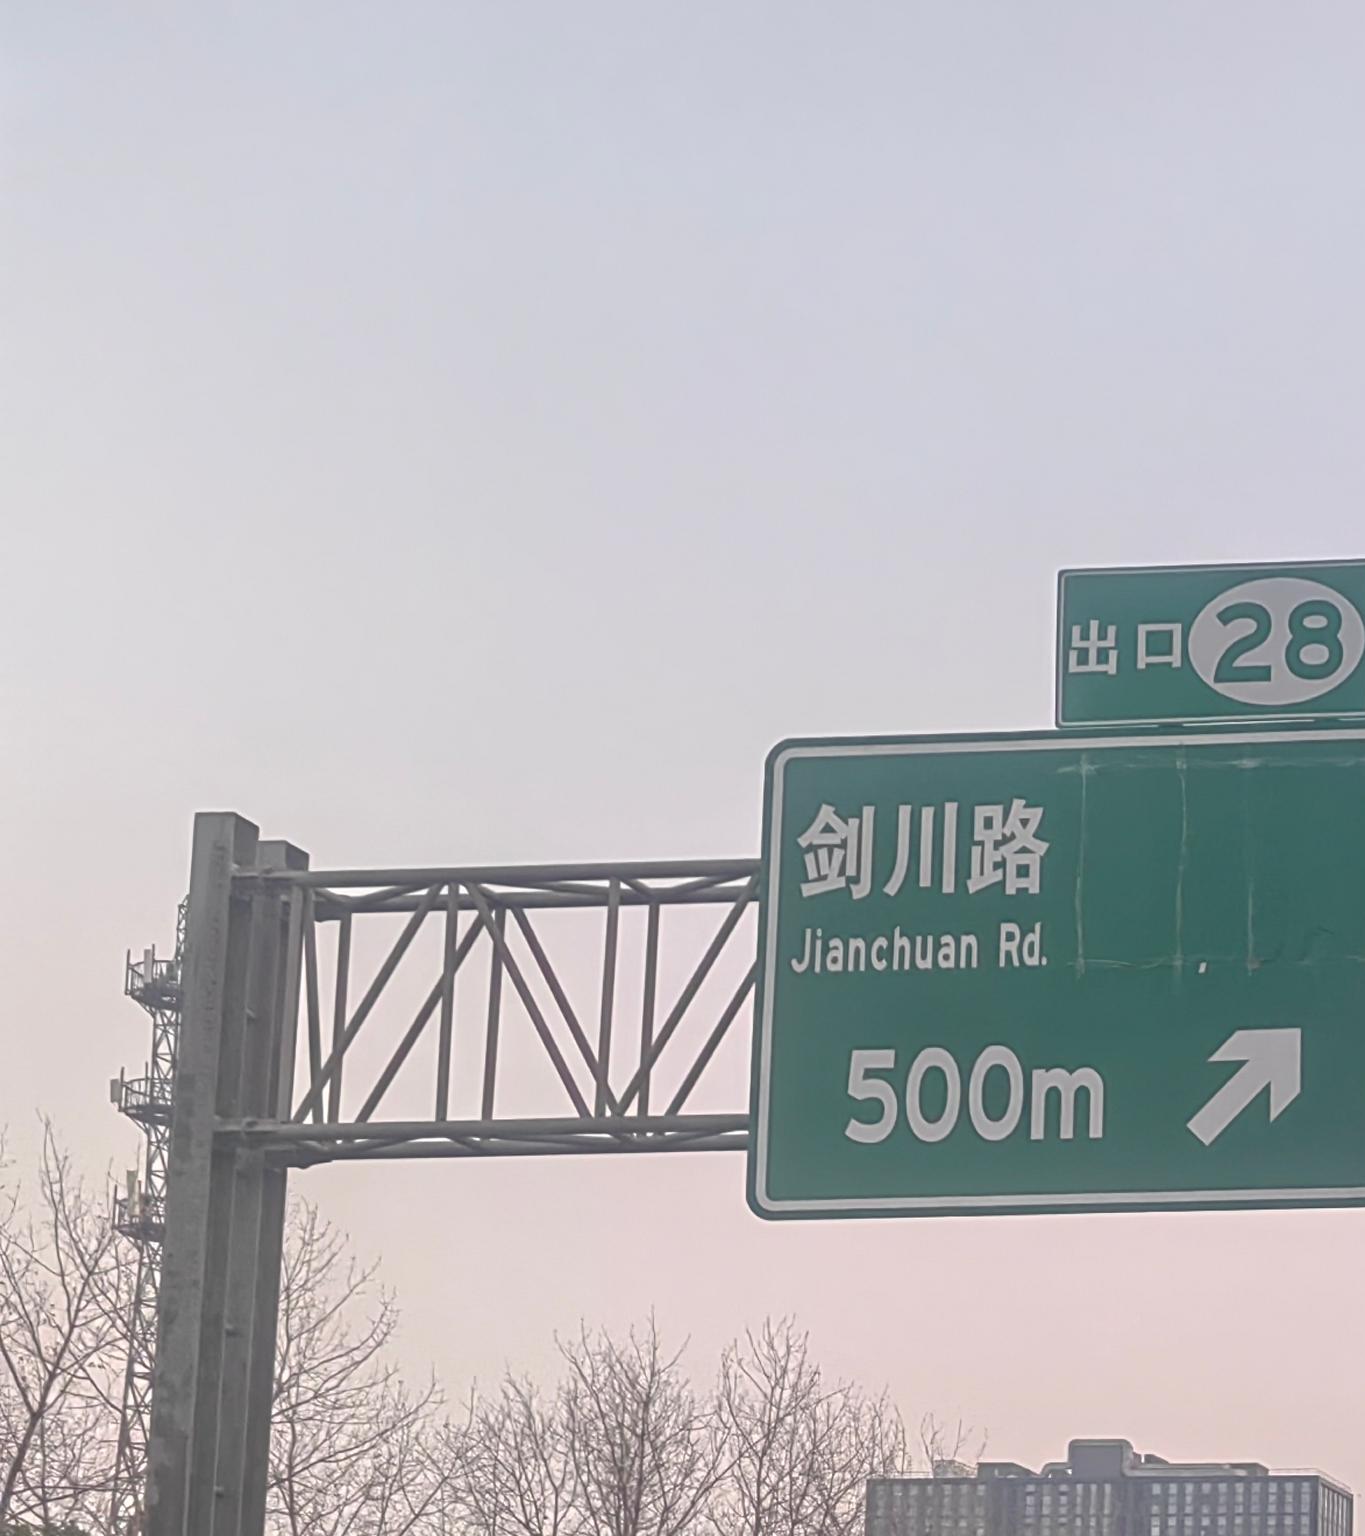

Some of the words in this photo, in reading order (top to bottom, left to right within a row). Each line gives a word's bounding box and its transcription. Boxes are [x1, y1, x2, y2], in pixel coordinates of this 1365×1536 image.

[1067, 619, 1183, 675] 出口
[1213, 598, 1344, 685] 28
[796, 797, 1050, 900] 剑川路
[790, 926, 979, 974] Jianchuan
[998, 921, 1049, 969] Rd.
[844, 1044, 1104, 1144] 500m
